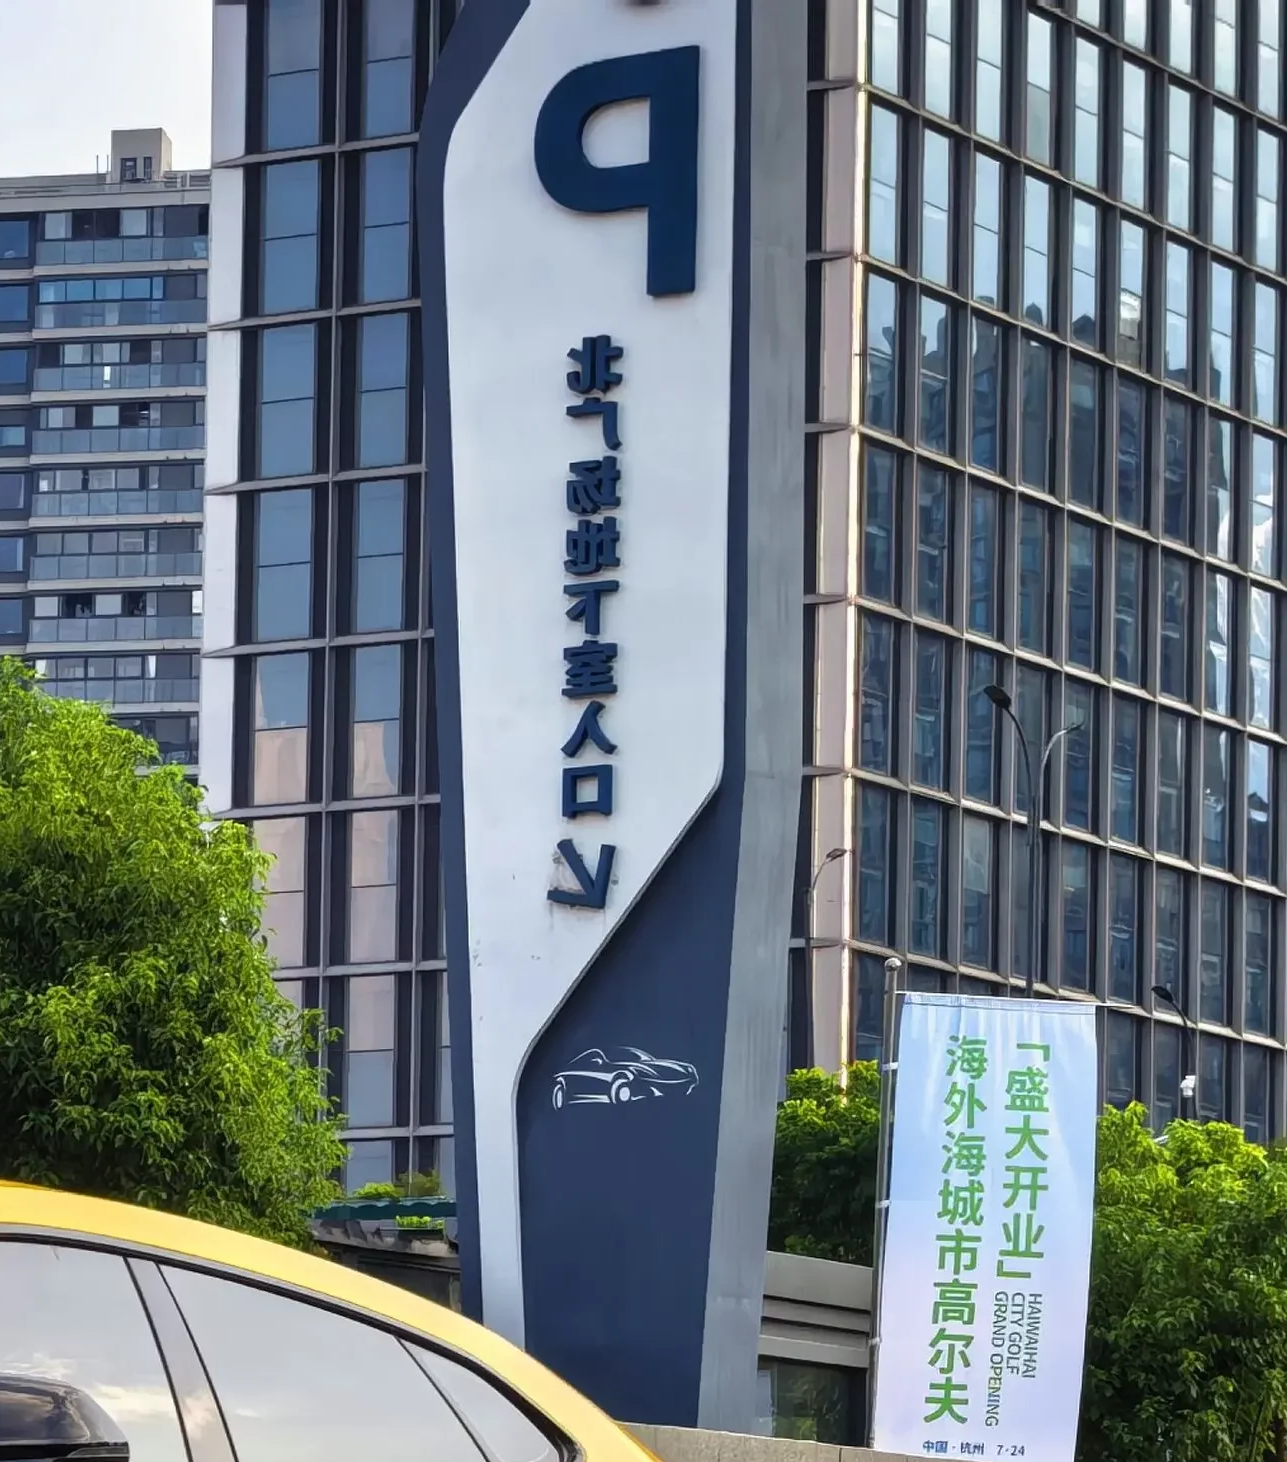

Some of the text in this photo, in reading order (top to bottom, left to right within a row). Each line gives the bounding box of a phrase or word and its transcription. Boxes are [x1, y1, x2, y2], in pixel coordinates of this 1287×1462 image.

[923, 1034, 988, 1425] 海外海城市高尔夫
[985, 1291, 1008, 1426] GRAND OPENING
[1006, 1292, 1025, 1375] CITY GOLF
[1022, 1293, 1042, 1378] HAIWAIHAI
